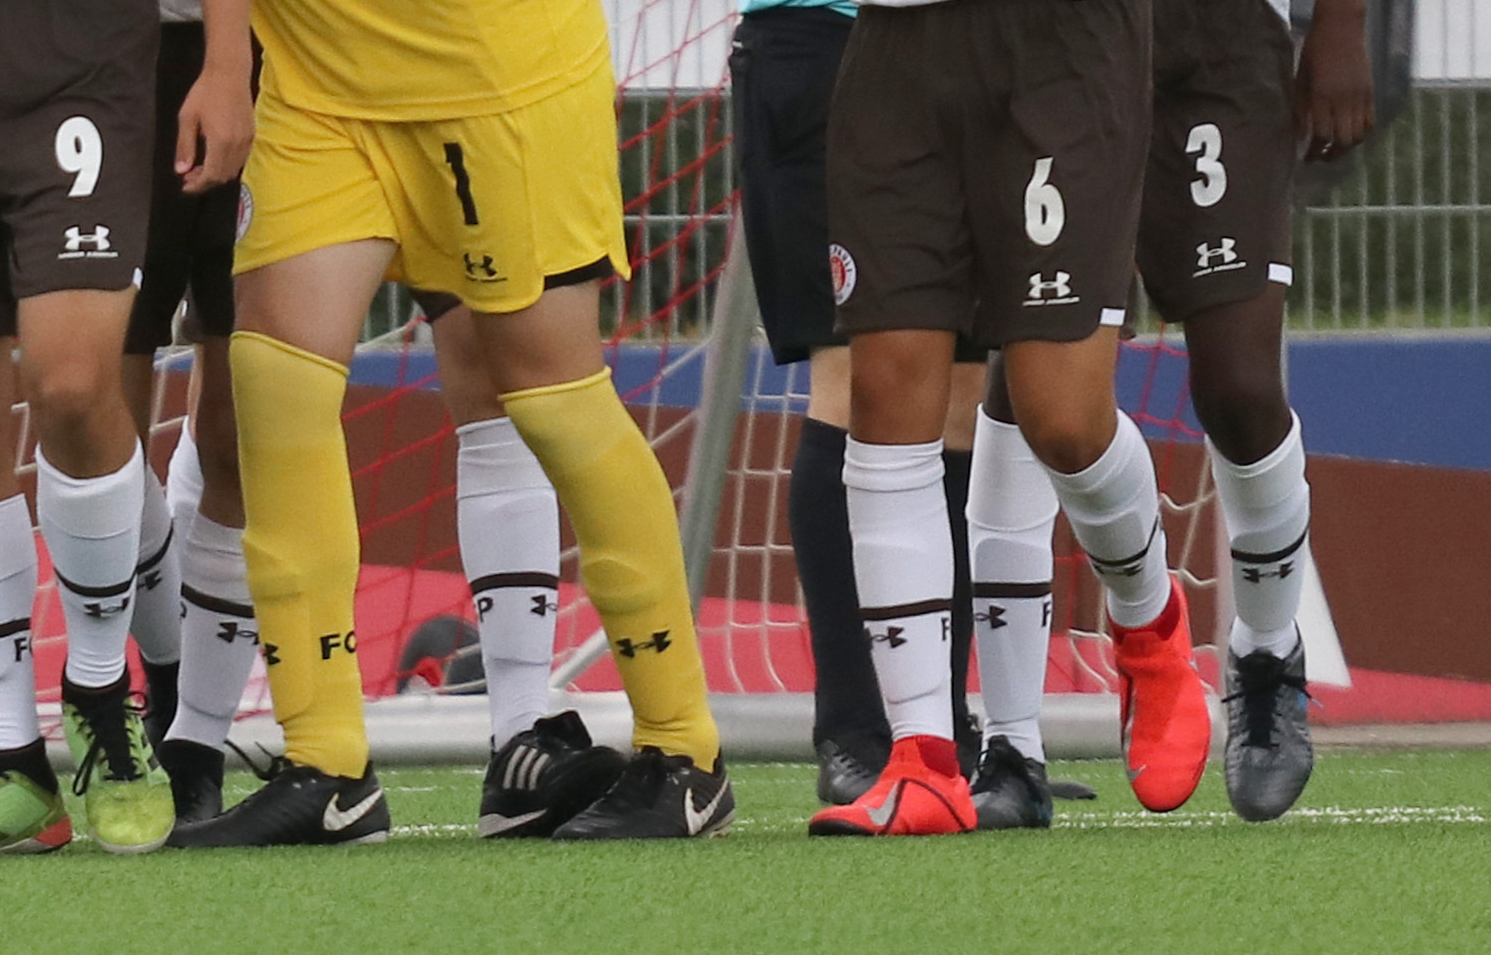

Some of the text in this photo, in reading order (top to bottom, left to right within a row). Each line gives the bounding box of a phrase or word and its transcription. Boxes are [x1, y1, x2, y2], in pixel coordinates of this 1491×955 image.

[55, 115, 103, 198] 9
[442, 142, 480, 226] 1
[1185, 122, 1228, 208] 3
[1024, 156, 1066, 246] 6
